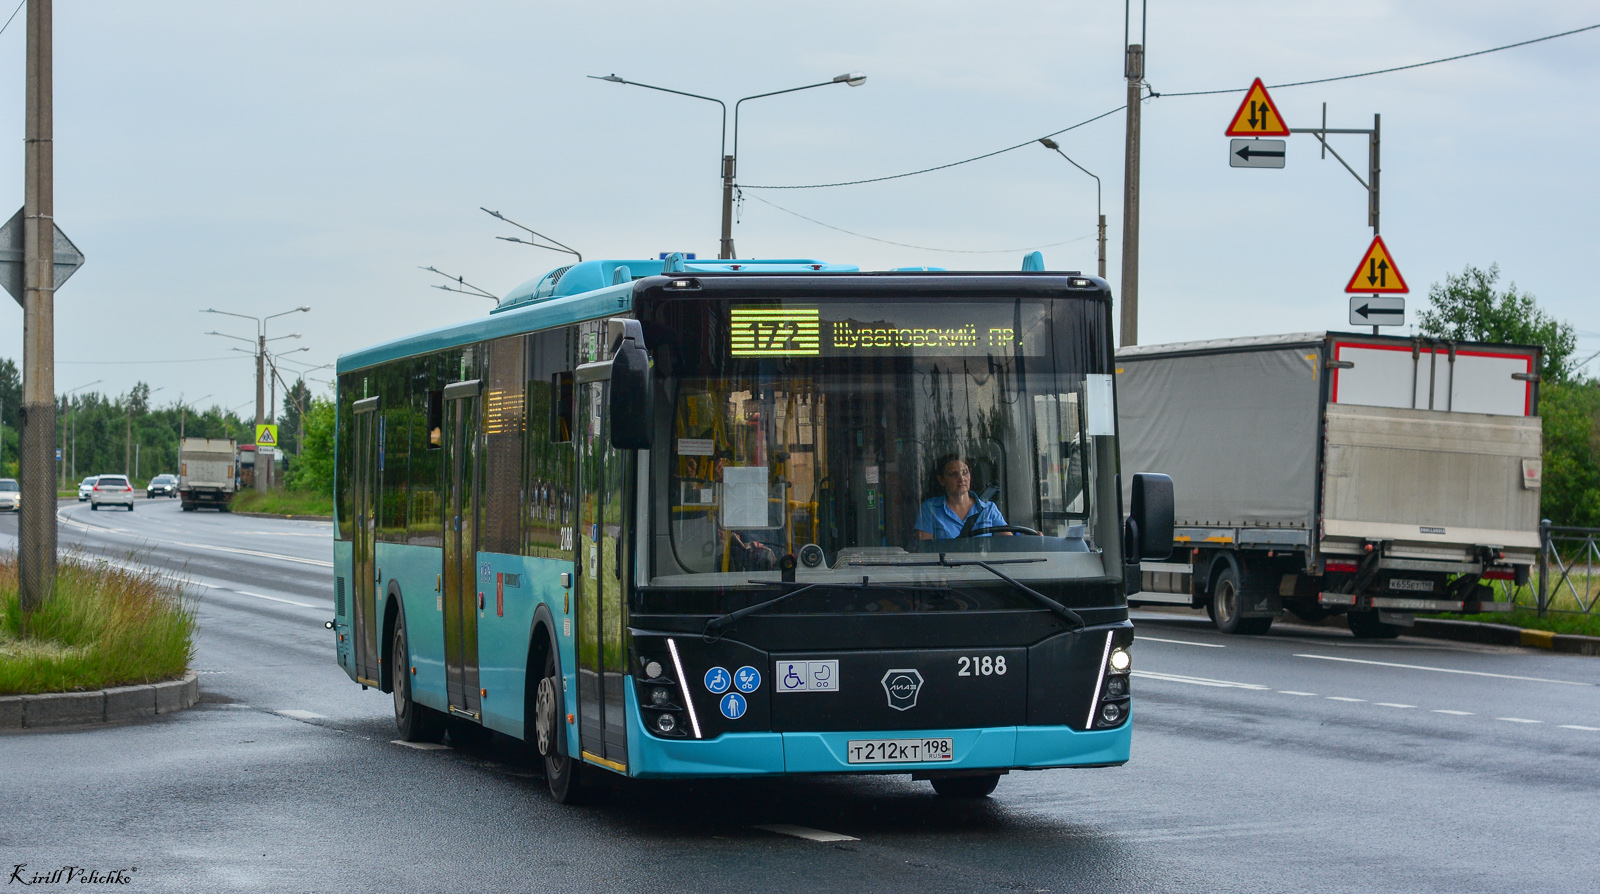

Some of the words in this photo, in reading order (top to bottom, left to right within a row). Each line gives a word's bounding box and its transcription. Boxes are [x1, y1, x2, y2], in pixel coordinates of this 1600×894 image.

[749, 322, 800, 349] 172
[833, 321, 977, 348] Шуваловский
[561, 527, 573, 551] 2188
[957, 655, 1007, 676] 2188
[923, 740, 948, 753] 198
